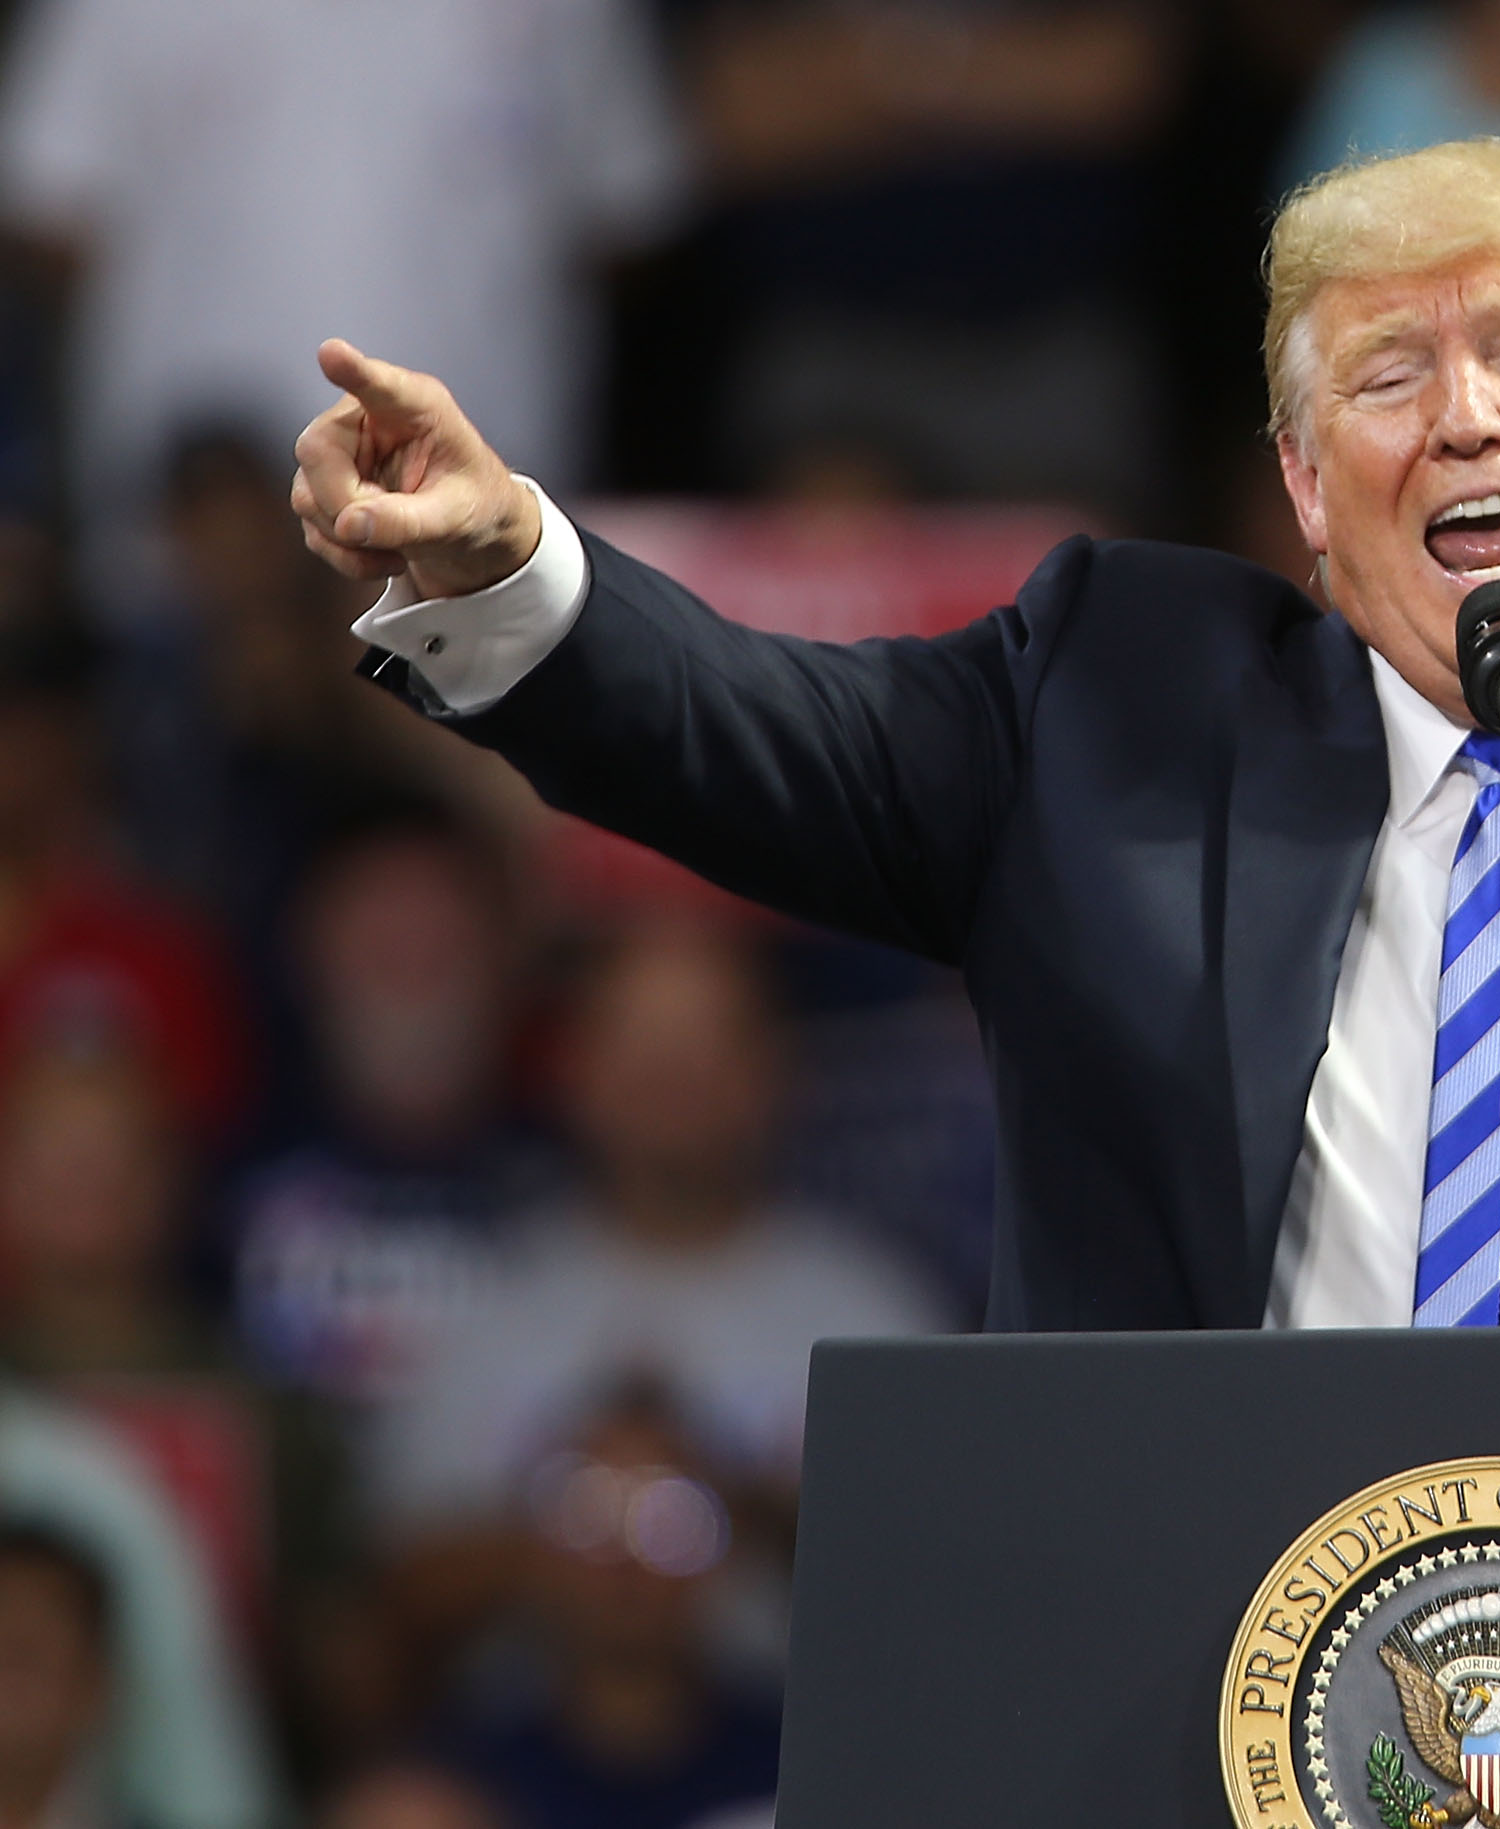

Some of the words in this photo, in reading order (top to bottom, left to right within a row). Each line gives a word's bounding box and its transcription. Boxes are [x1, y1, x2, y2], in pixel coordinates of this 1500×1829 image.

[1239, 1477, 1478, 1718] PRESIDENT
[1441, 1671, 1452, 1682] E
[1246, 1739, 1286, 1813] THE
